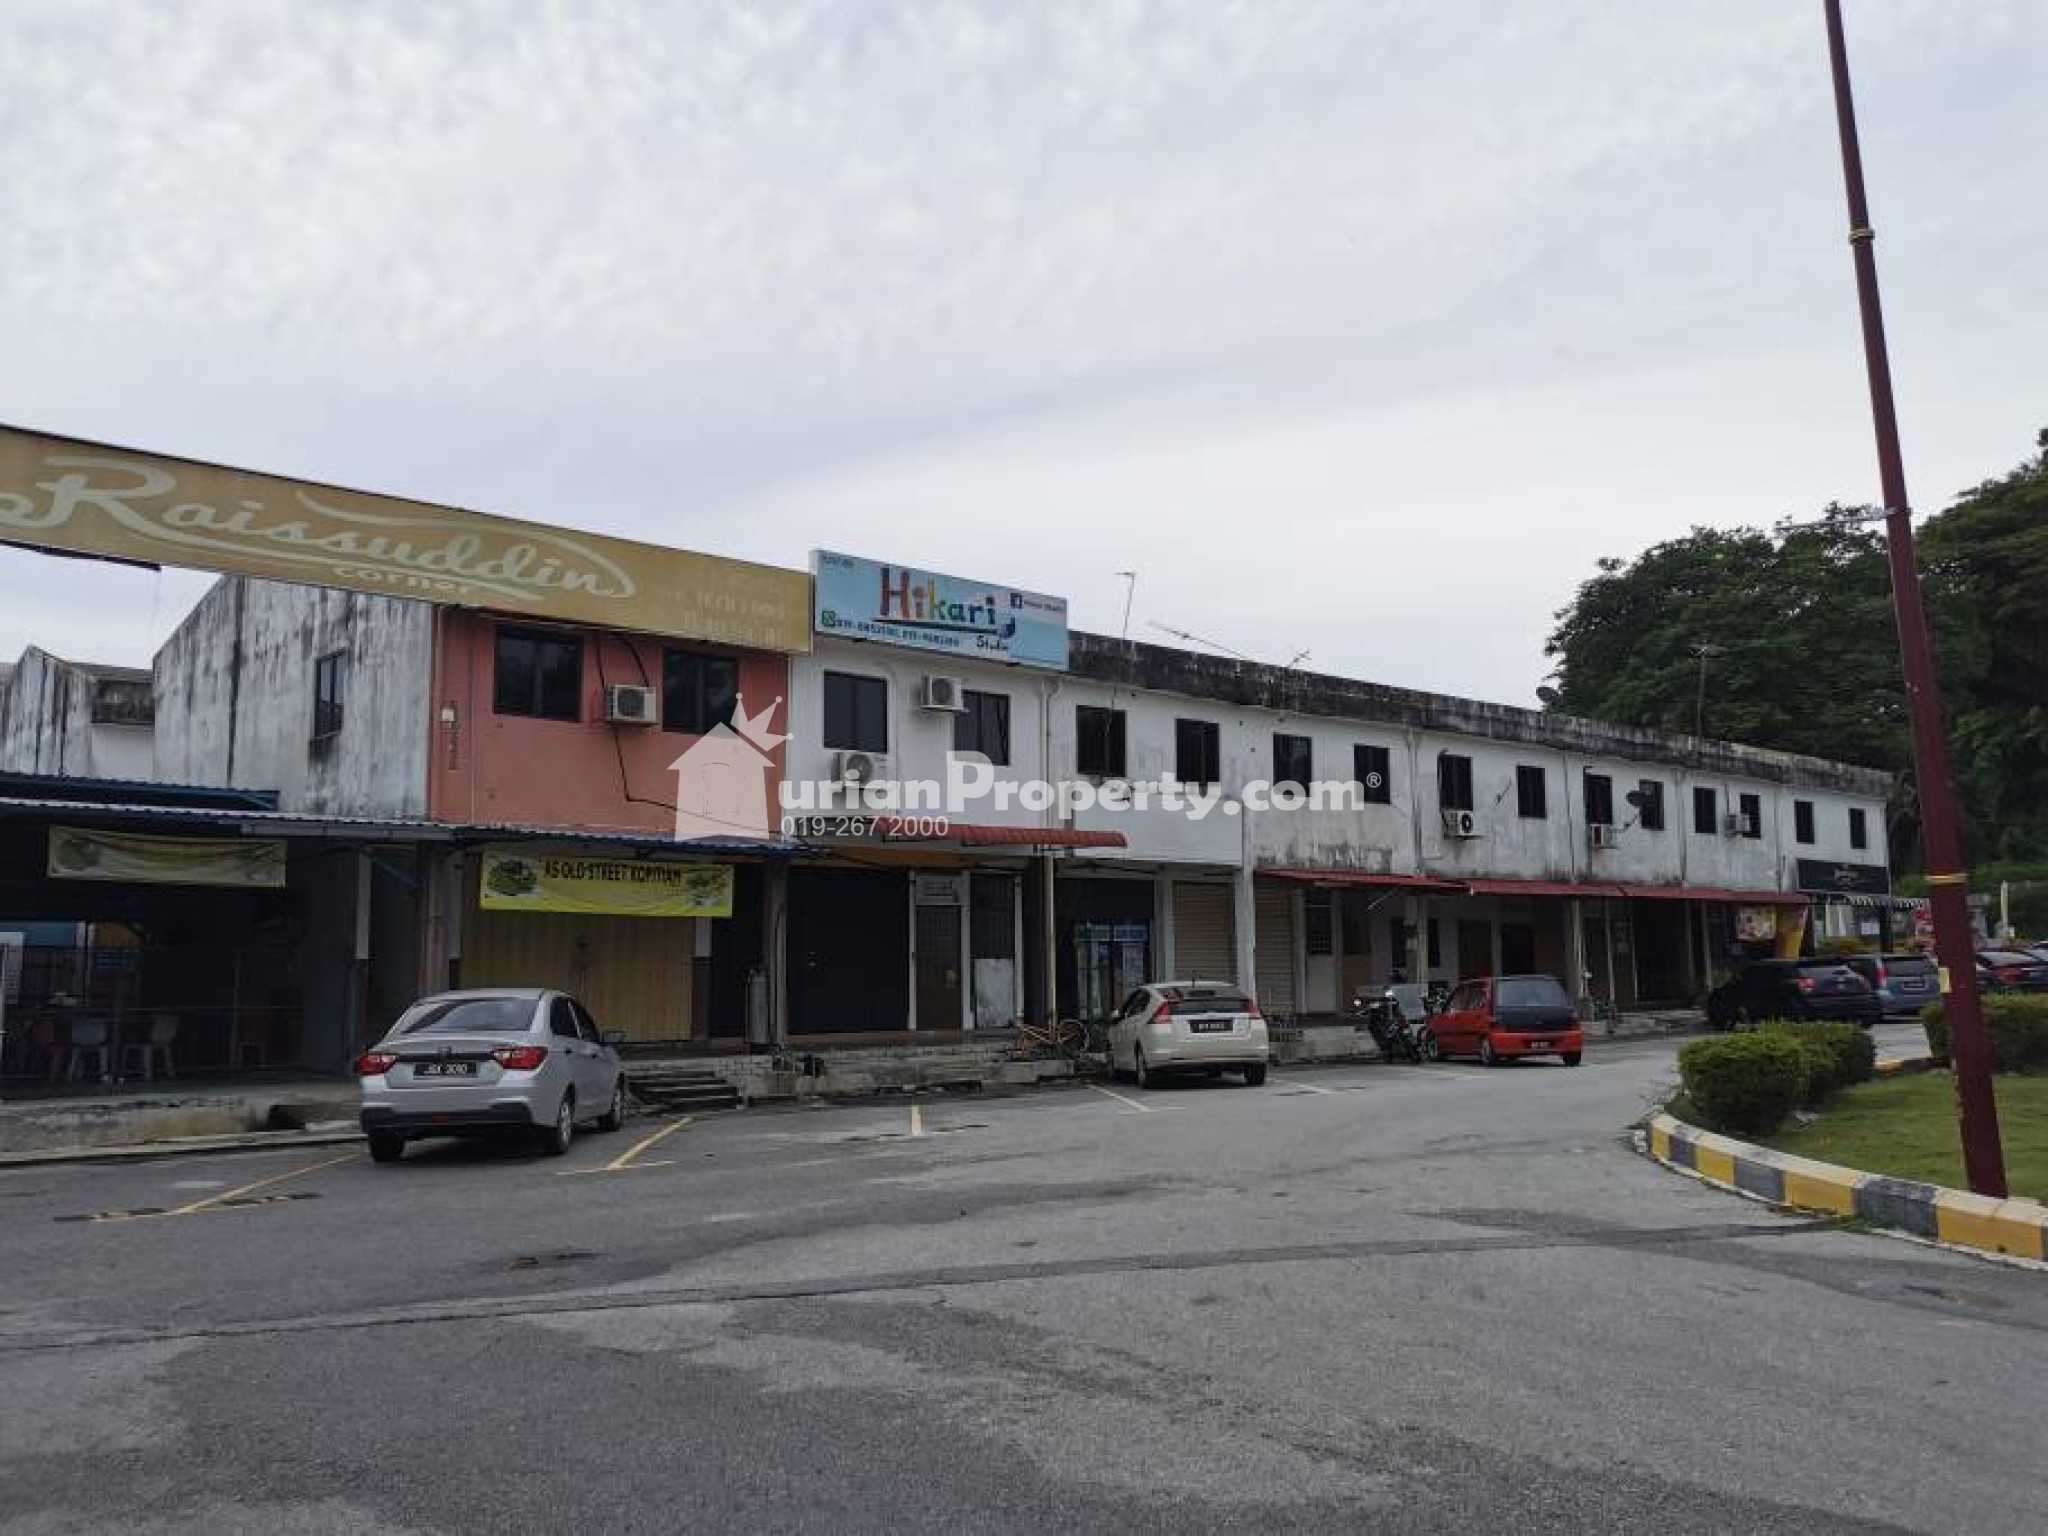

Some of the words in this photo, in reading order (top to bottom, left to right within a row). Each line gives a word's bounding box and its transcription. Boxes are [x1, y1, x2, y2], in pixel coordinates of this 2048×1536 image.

[0, 456, 630, 599] Raissuddin
[879, 567, 996, 625] Hikari
[585, 862, 628, 881] STREET
